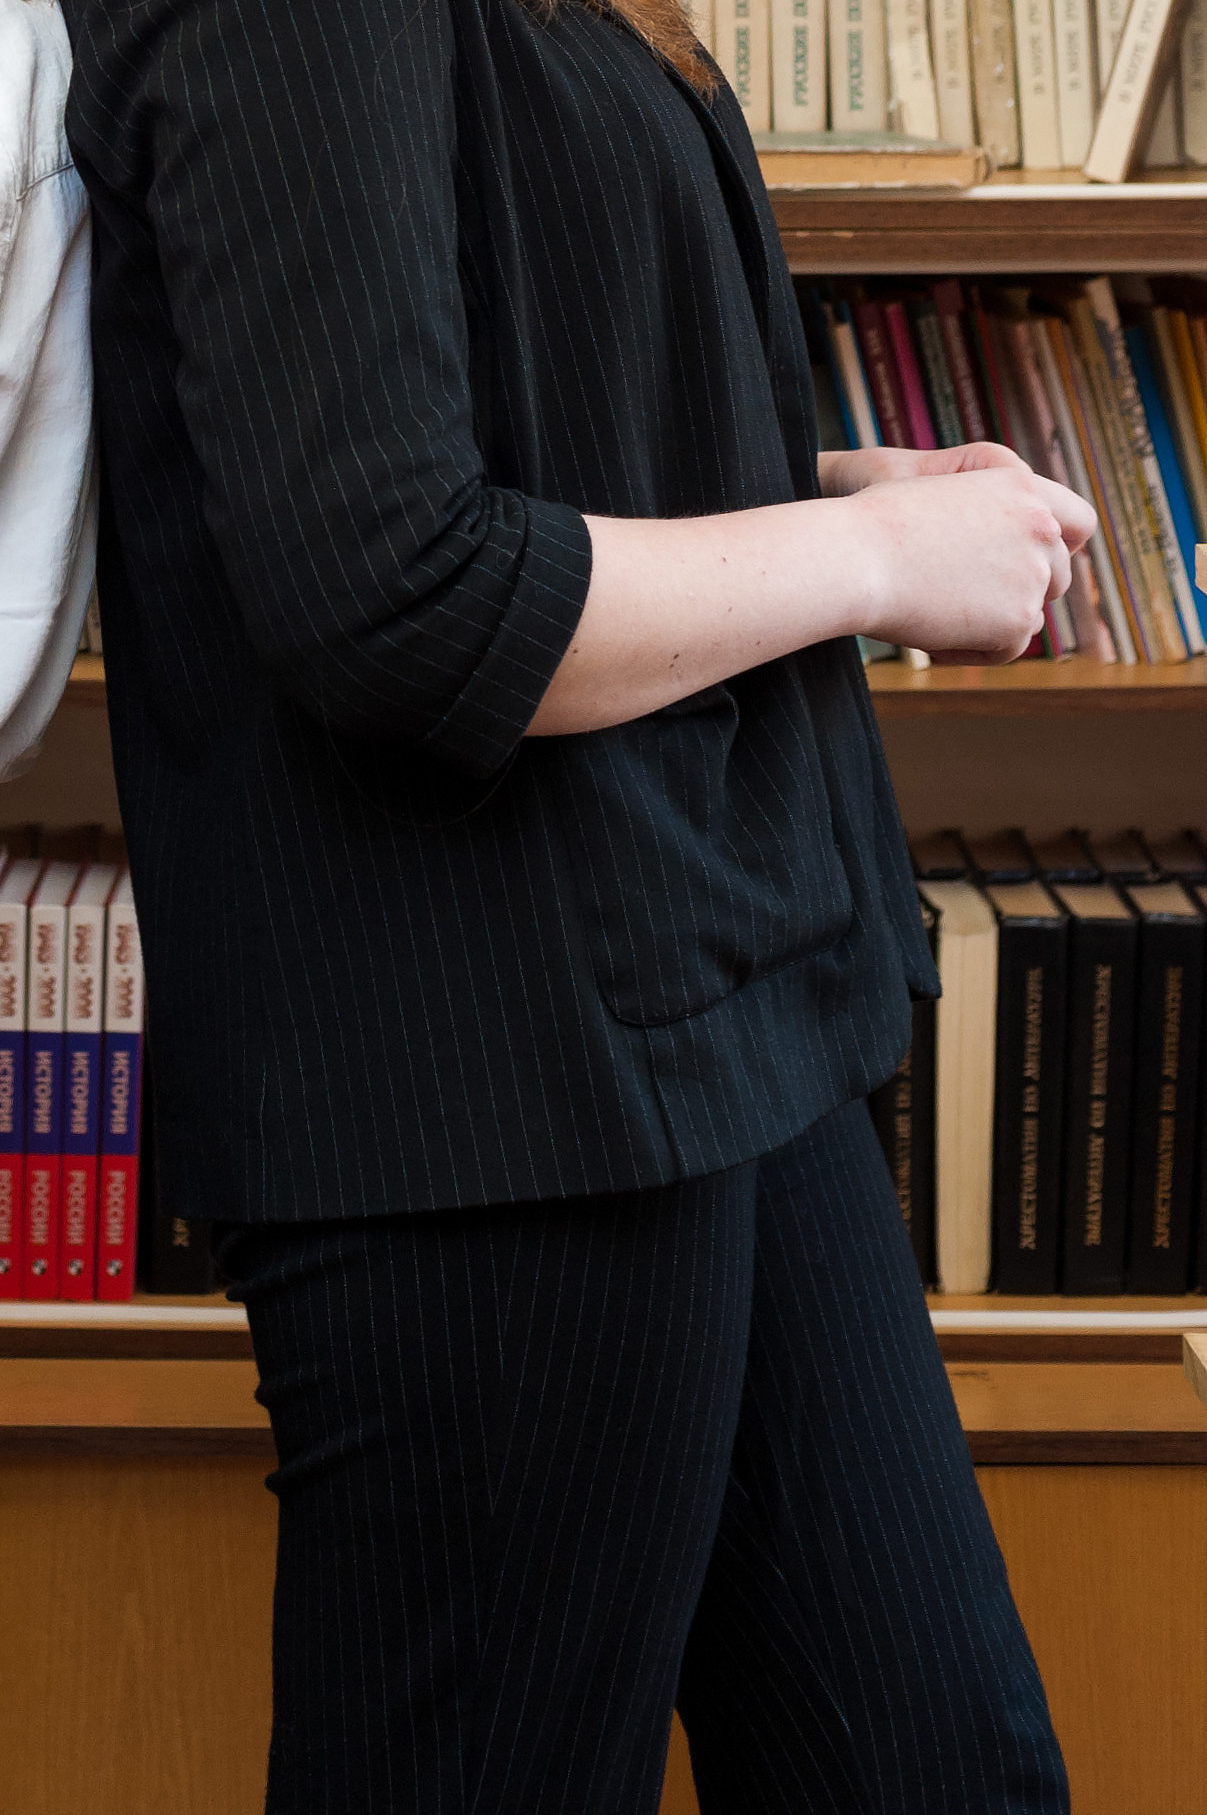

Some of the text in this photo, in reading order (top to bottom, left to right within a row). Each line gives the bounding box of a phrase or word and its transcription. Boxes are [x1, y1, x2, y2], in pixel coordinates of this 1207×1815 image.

[31, 1049, 51, 1245] ИСТОРИЯ РОССИИ
[67, 1049, 89, 1245] ИСТОРИЯ РОССИИ
[106, 1049, 129, 1245] ИСТОРИЯ РОССИИ
